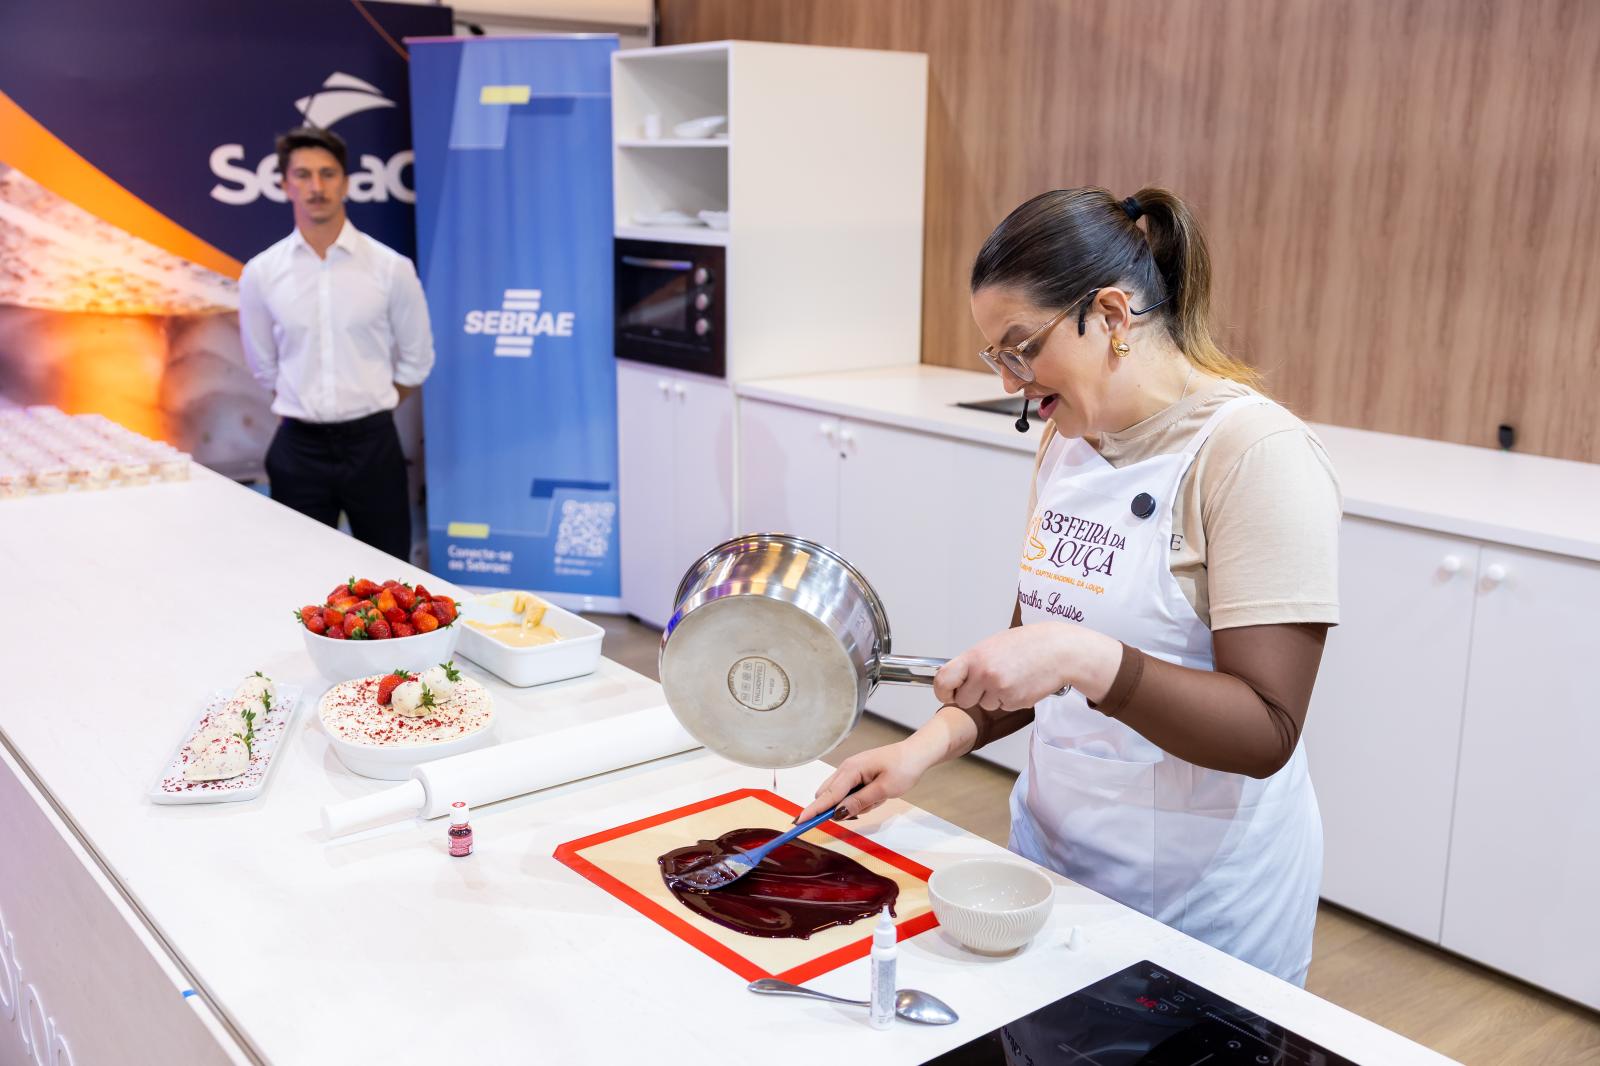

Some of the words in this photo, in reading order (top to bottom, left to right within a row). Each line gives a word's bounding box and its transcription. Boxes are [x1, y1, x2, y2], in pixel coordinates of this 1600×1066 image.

[209, 143, 416, 206] Seac
[464, 311, 575, 337] SEBRAE
[1064, 516, 1112, 546] FEIRA
[1109, 533, 1126, 551] DA
[1048, 537, 1115, 577] LOUÇA
[1045, 591, 1085, 623] Louise
